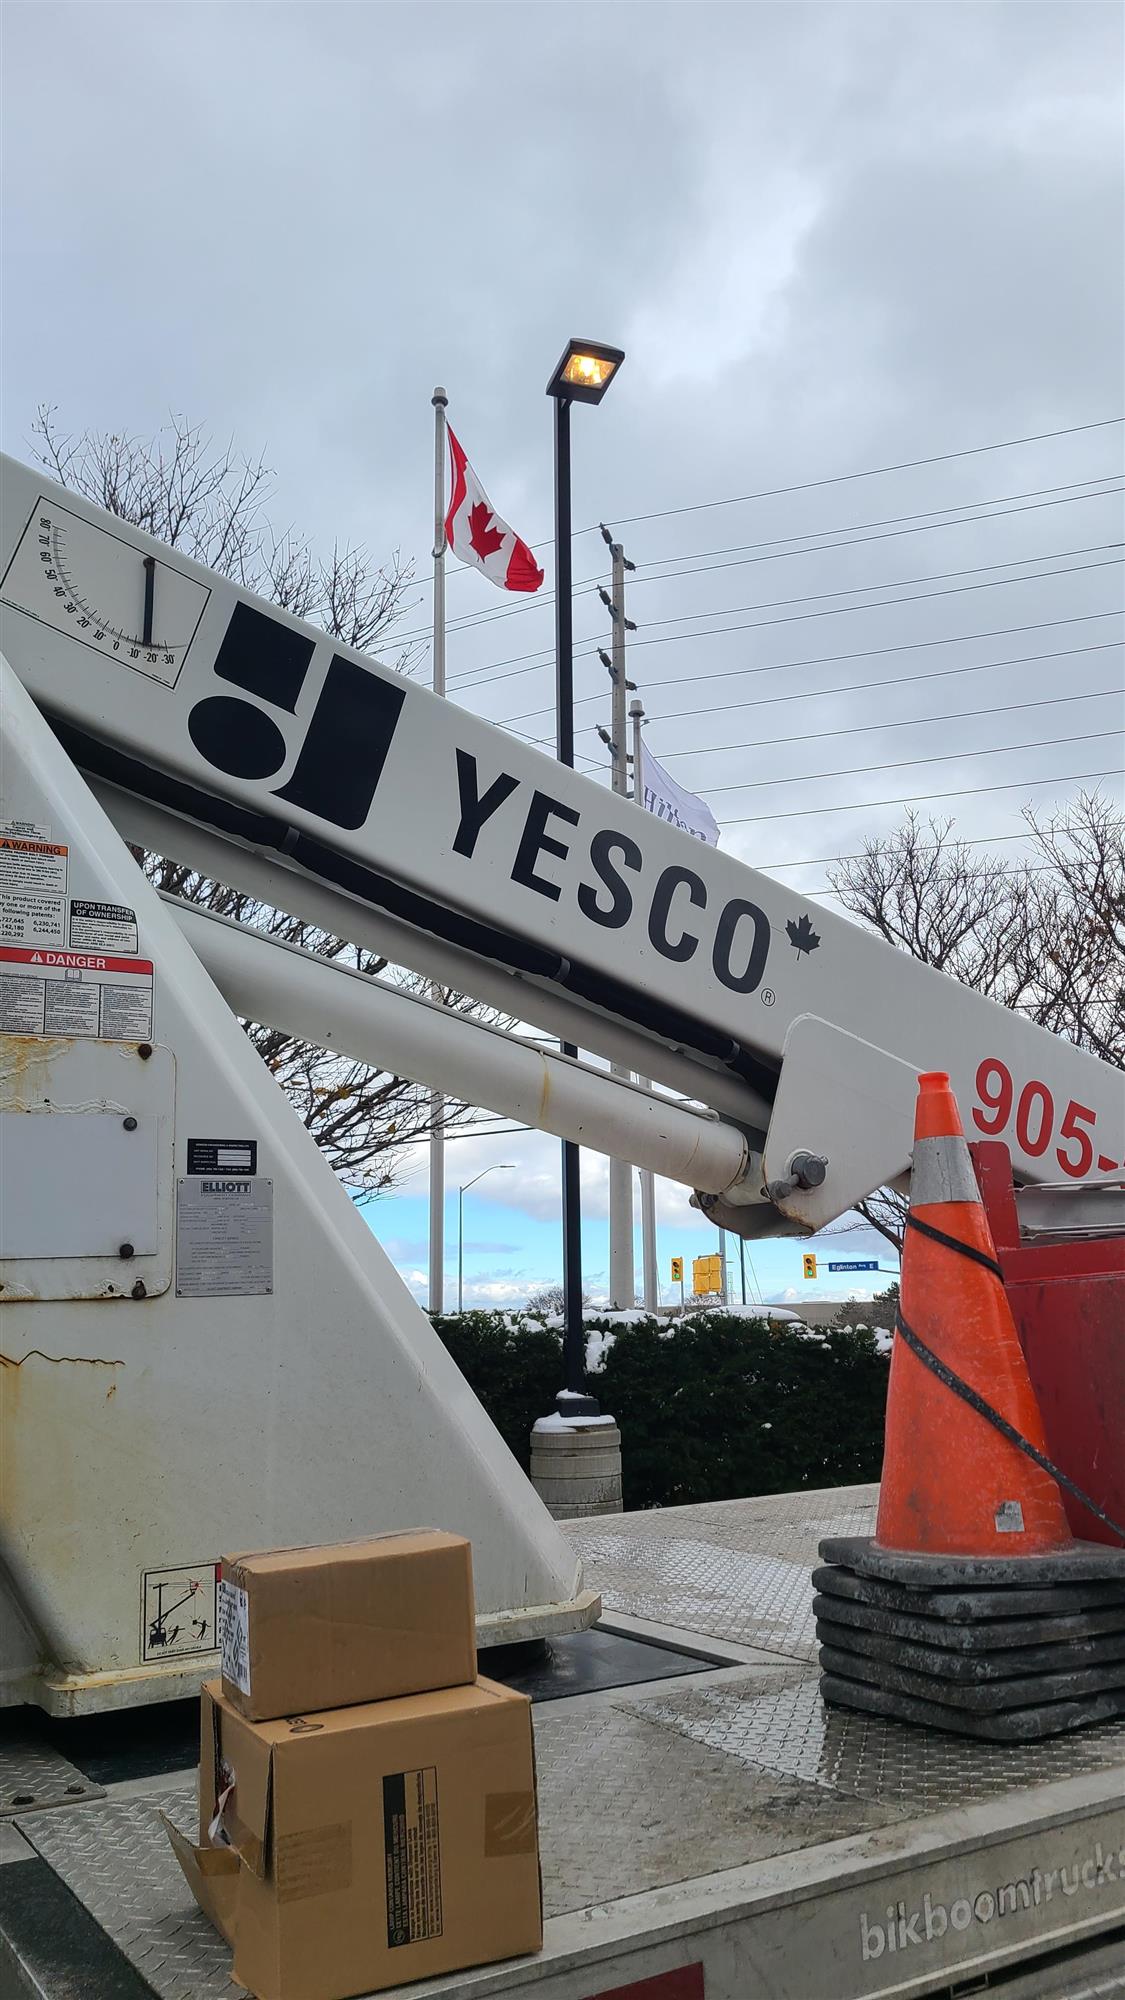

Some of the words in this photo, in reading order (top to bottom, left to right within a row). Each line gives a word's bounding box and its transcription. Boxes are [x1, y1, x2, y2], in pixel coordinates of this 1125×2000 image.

[12, 841, 61, 855] WARNING
[451, 747, 771, 994] YESCO
[12, 895, 36, 903] product
[2, 908, 30, 917] following
[73, 901, 96, 910] UPON
[96, 904, 135, 917] TRANSFER
[88, 910, 133, 921] OWNERSHIP
[45, 953, 106, 969] DANGER
[202, 1182, 250, 1193] ELLIOTT
[831, 1263, 858, 1271] Eglinton
